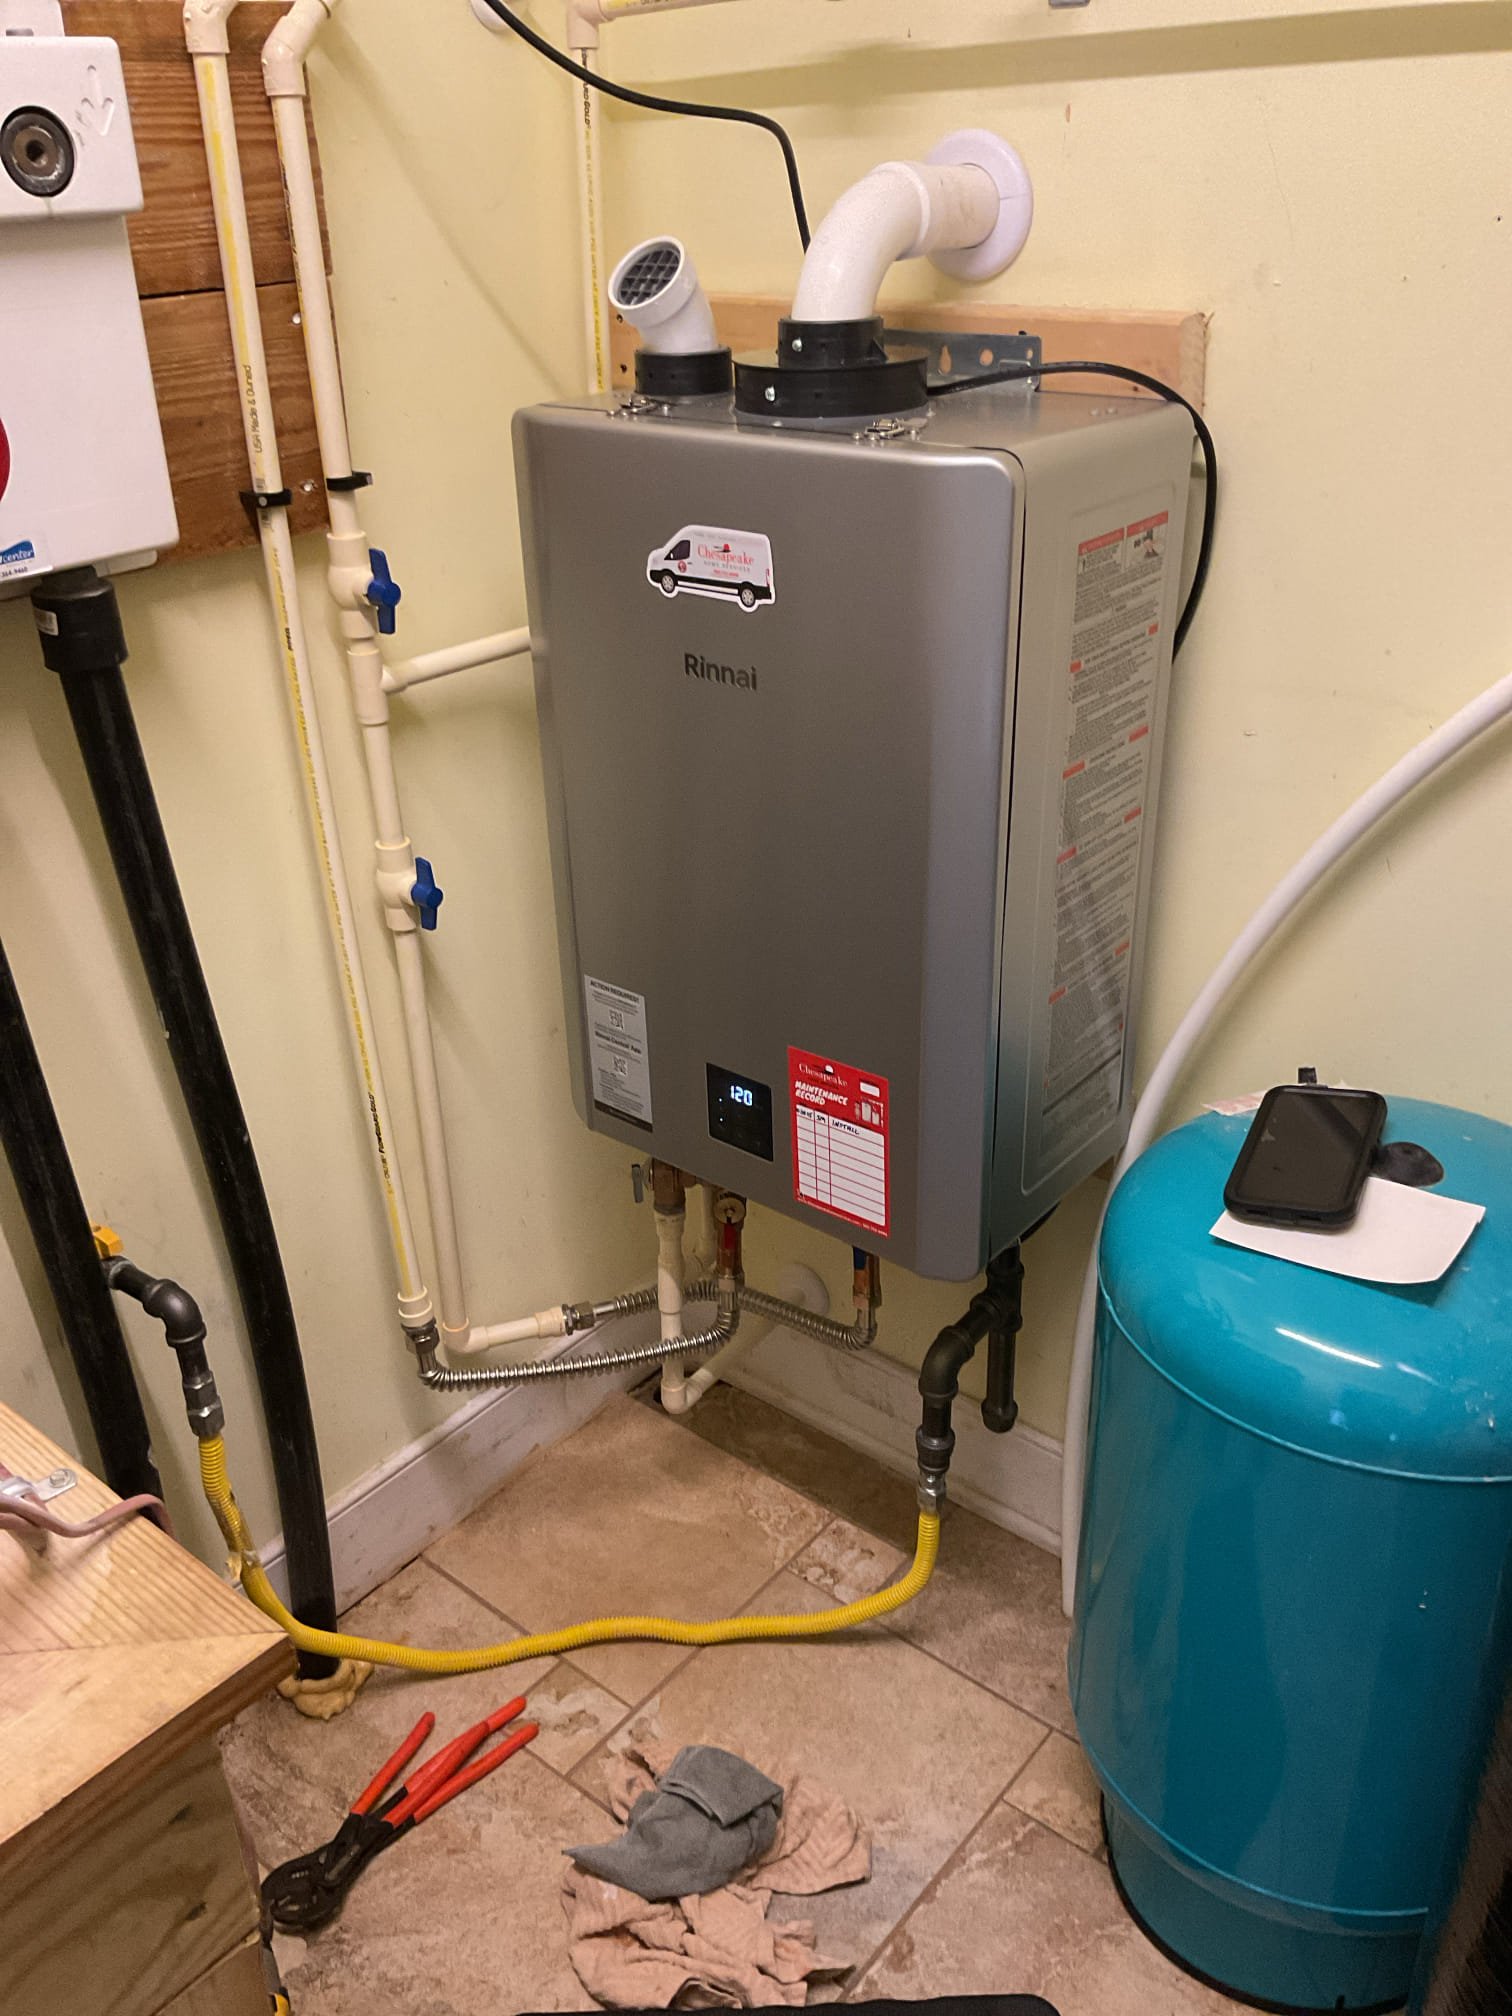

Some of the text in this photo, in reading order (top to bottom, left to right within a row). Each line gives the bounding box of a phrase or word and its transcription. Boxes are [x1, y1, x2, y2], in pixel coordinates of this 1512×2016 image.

[698, 544, 753, 566] Chesapeake
[684, 653, 757, 690] Rinnai
[799, 1063, 848, 1087] Chesapeake
[730, 1085, 753, 1106] 120
[795, 1081, 848, 1105] MAINTENANCE
[795, 1090, 825, 1105] RECORD
